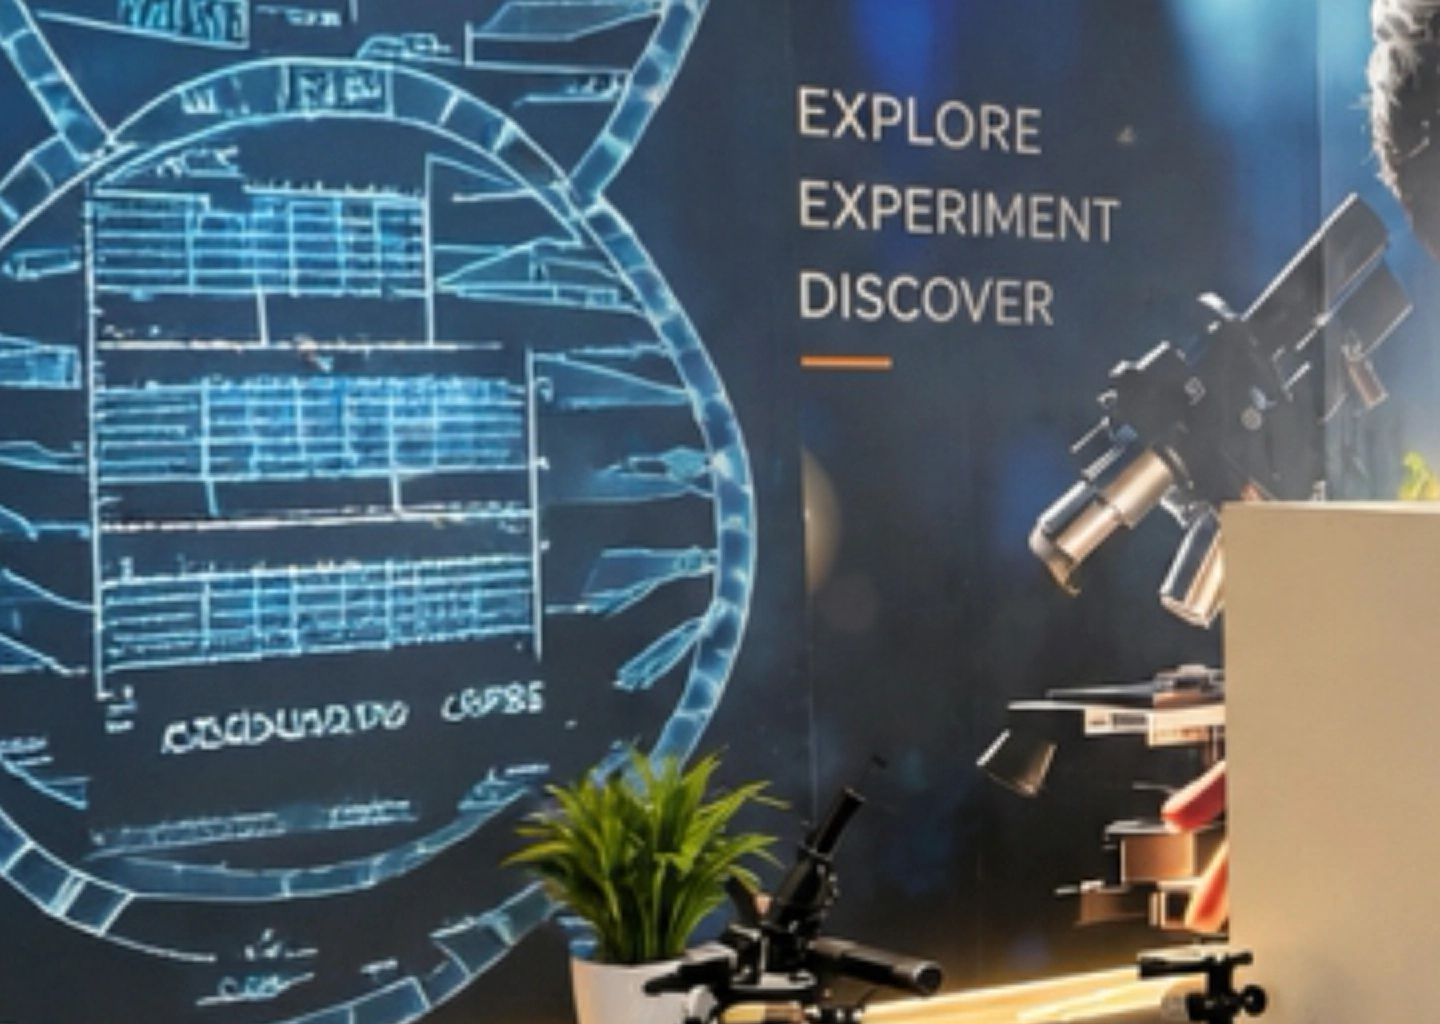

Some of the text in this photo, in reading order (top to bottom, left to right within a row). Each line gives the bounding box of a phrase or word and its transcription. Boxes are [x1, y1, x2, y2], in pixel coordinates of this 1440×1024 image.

[798, 86, 1041, 154] EXPLORE
[800, 180, 1120, 242] EXPERIMENT
[800, 271, 1053, 325] DISCOVER
